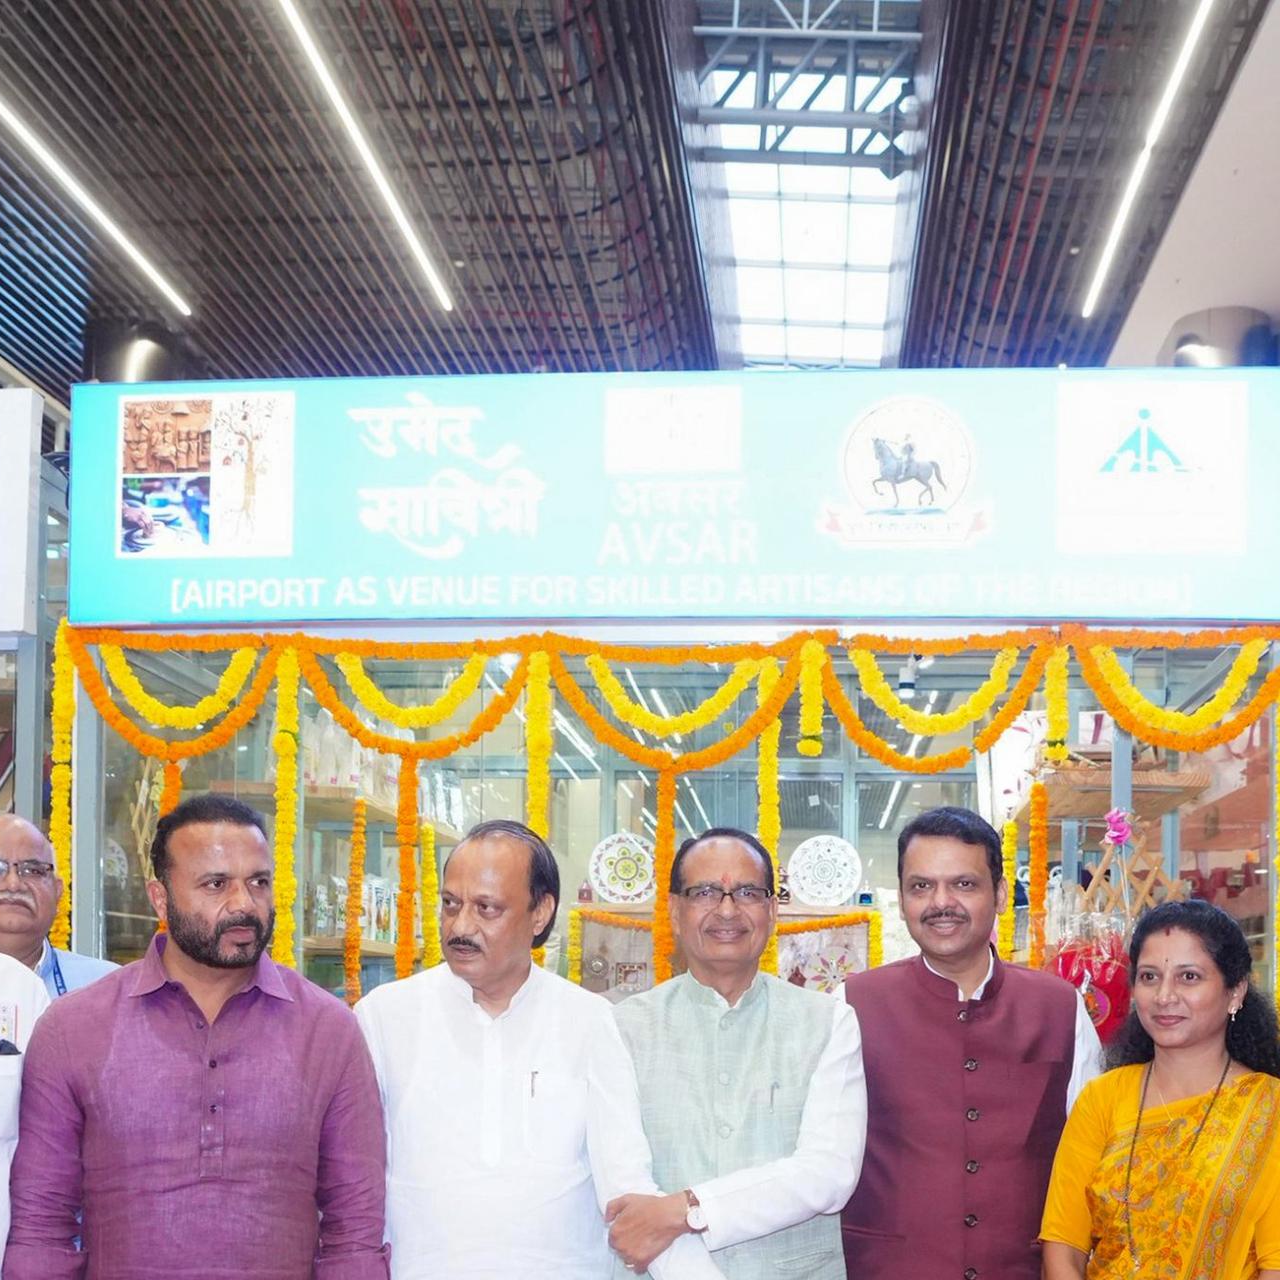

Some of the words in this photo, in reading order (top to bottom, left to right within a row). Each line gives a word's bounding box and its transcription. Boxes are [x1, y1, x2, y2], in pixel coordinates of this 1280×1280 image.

[596, 520, 760, 567] AVSAR
[335, 575, 378, 606] AS
[387, 575, 502, 606] VENUE
[511, 575, 579, 606] FOR
[586, 574, 725, 606] SKILLED
[736, 573, 905, 605] ARTISANS
